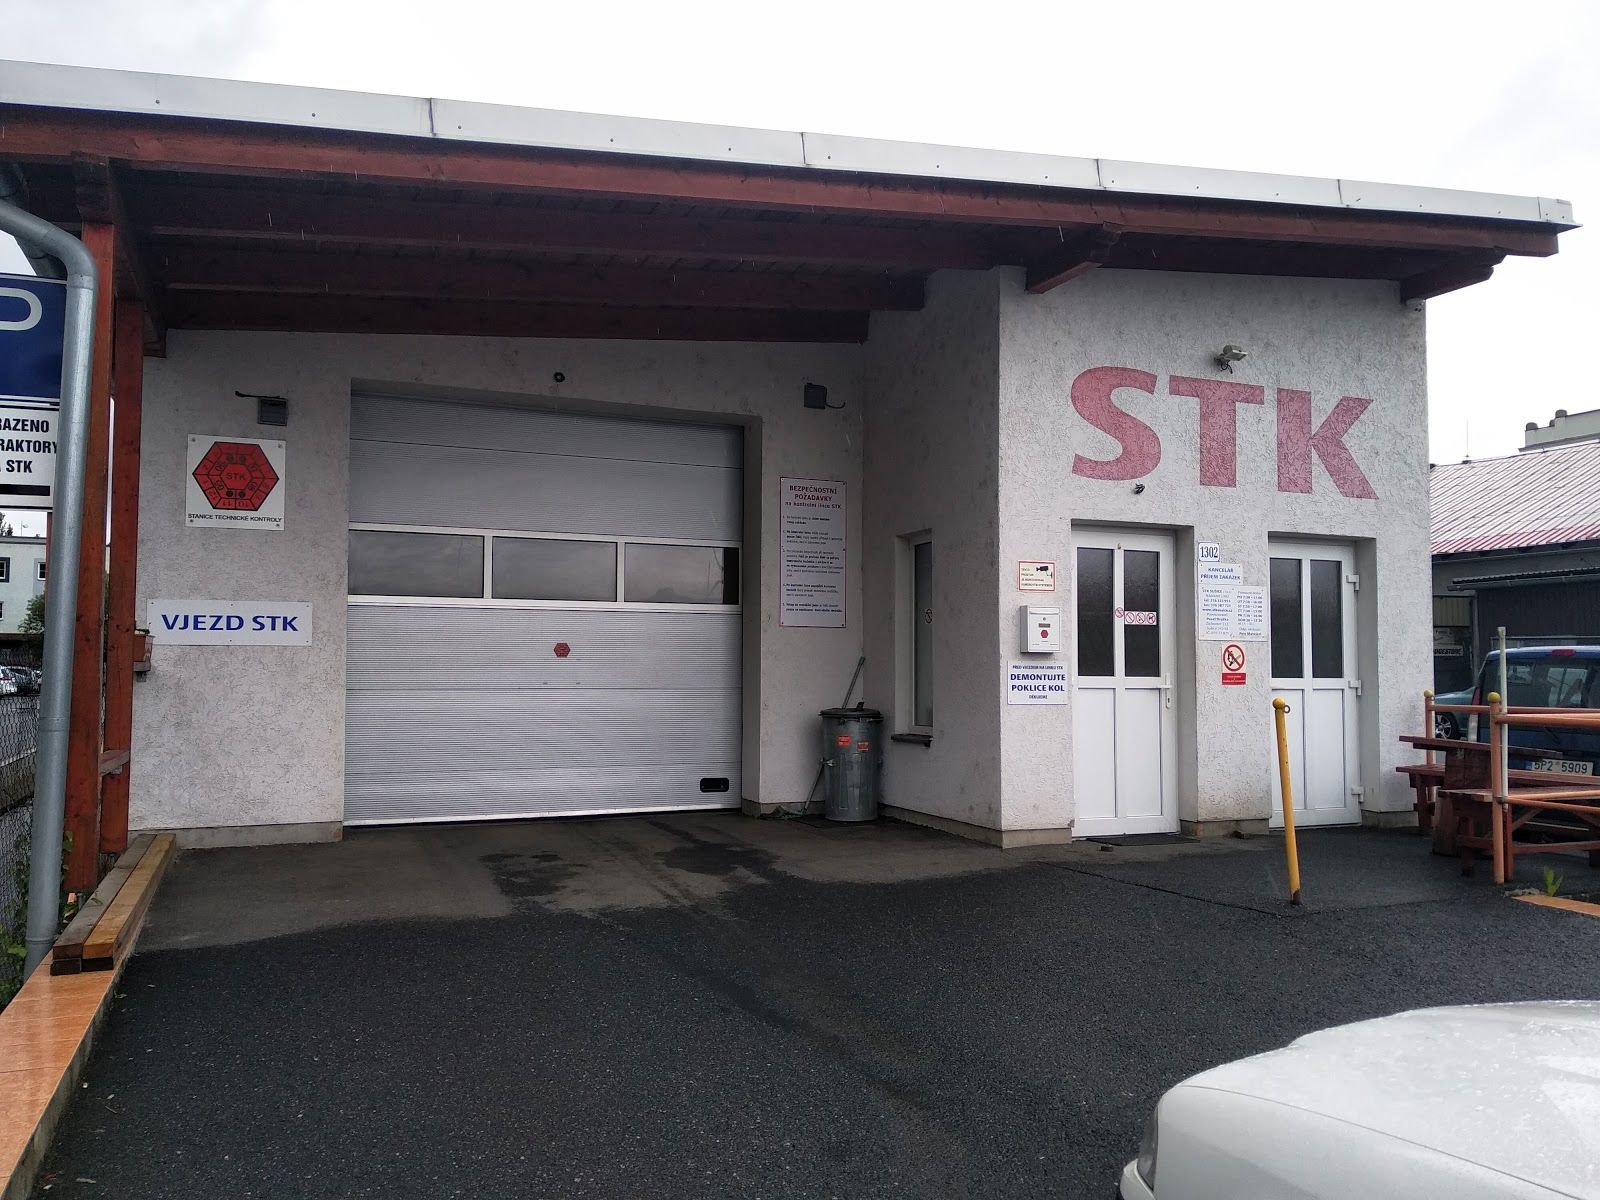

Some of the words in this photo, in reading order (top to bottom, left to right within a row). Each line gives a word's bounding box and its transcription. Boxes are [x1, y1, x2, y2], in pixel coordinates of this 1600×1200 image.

[0, 418, 50, 433] AZENO
[1070, 366, 1379, 500] STK
[6, 459, 33, 473] STK
[226, 472, 246, 480] STK
[1200, 546, 1218, 559] 1302
[161, 614, 244, 631] VJEZD
[252, 615, 299, 632] STK
[1010, 673, 1066, 681] DEMONTUJTE
[1011, 684, 1047, 692] POKLICE
[1048, 684, 1065, 692] KOL
[1534, 760, 1553, 772] 5P2
[1561, 761, 1588, 774] 5909
